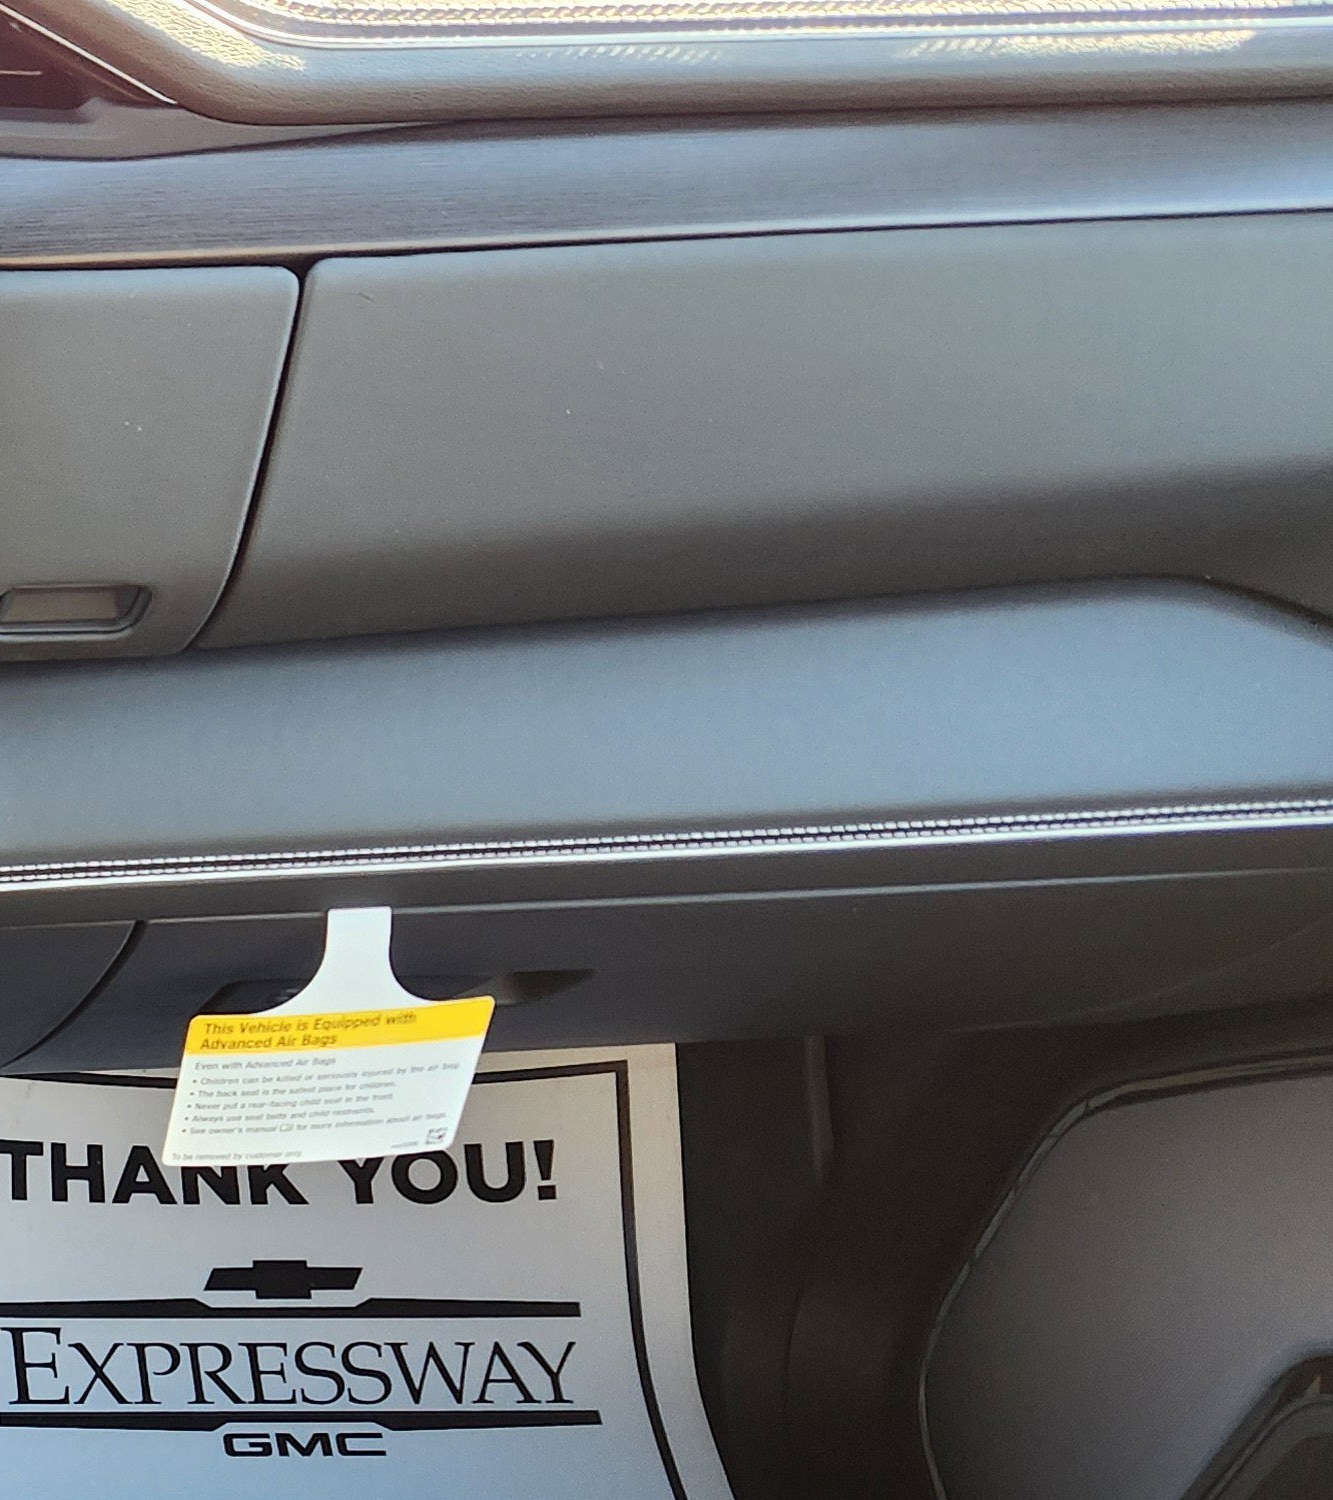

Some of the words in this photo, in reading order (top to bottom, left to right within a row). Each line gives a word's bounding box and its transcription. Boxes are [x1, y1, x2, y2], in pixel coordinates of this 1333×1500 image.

[205, 1022, 234, 1035] This
[239, 1020, 293, 1034] Vehicle
[296, 1020, 308, 1032] is
[313, 1013, 381, 1032] Equipped
[386, 1012, 417, 1026] with
[201, 1036, 272, 1050] Advanced
[276, 1035, 297, 1048] Air
[301, 1033, 337, 1048] Bags
[338, 1138, 558, 1205] YOU!
[222, 1432, 388, 1458] GMC
